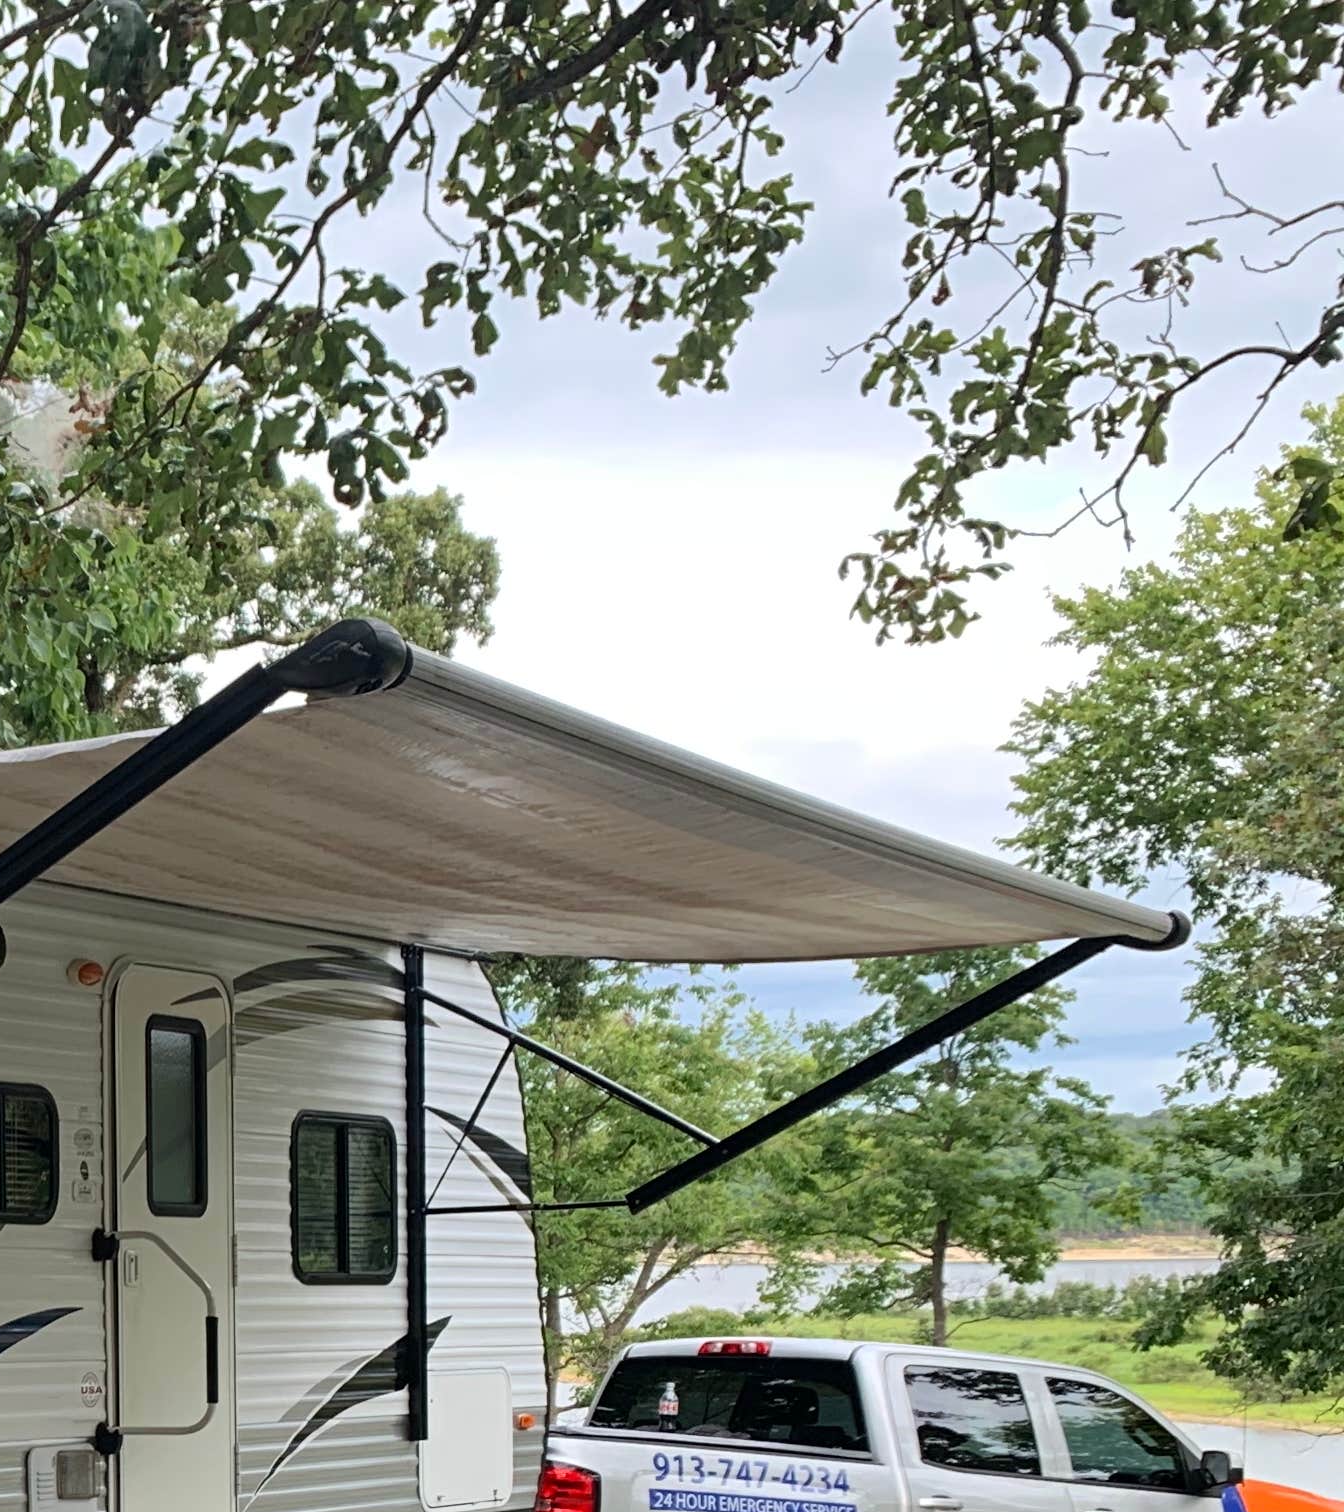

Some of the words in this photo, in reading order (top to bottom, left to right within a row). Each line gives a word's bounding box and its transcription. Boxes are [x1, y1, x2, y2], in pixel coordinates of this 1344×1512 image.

[81, 1386, 103, 1394] USA
[652, 1452, 850, 1496] 913-747-4234
[653, 1492, 673, 1509] 24
[675, 1494, 717, 1512] HOUR
